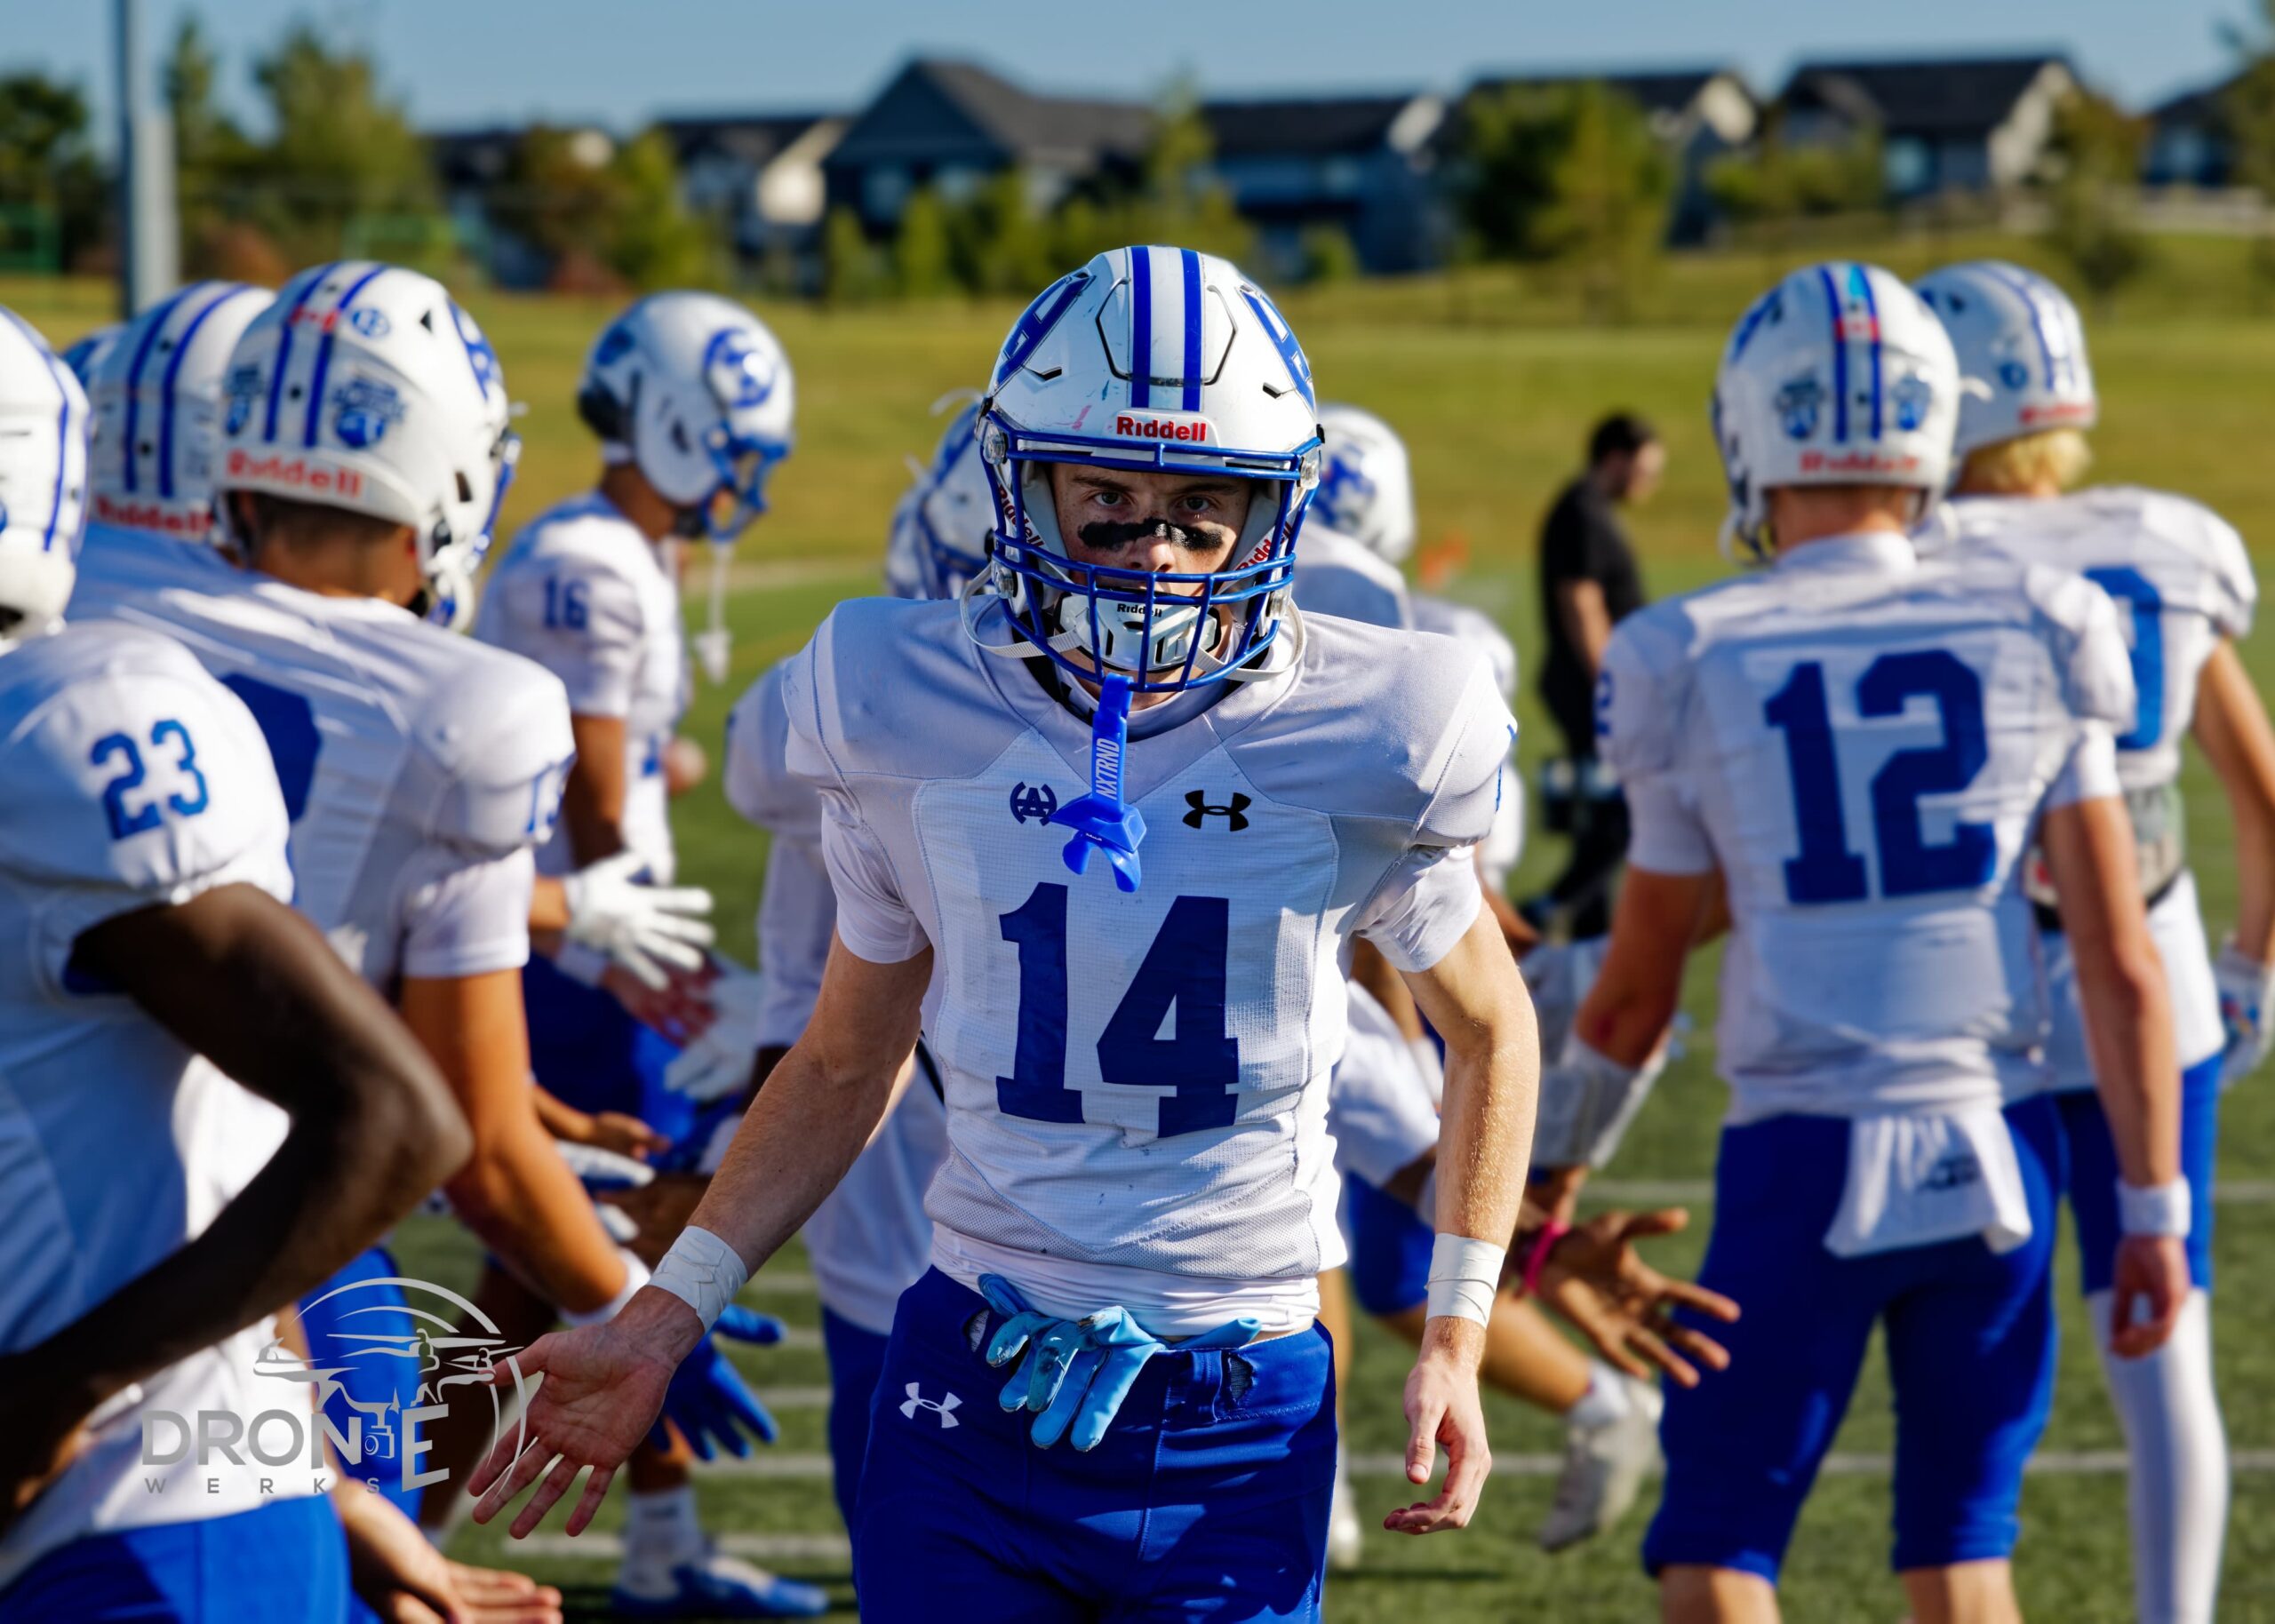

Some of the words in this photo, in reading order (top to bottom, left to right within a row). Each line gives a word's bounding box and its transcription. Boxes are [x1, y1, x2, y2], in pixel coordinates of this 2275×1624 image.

[1116, 416, 1207, 442] Riddell
[542, 577, 591, 632] 16
[92, 720, 209, 840] 23
[1095, 737, 1120, 800] NXTRND
[1763, 649, 1998, 904] 12
[996, 881, 1240, 1139] 14
